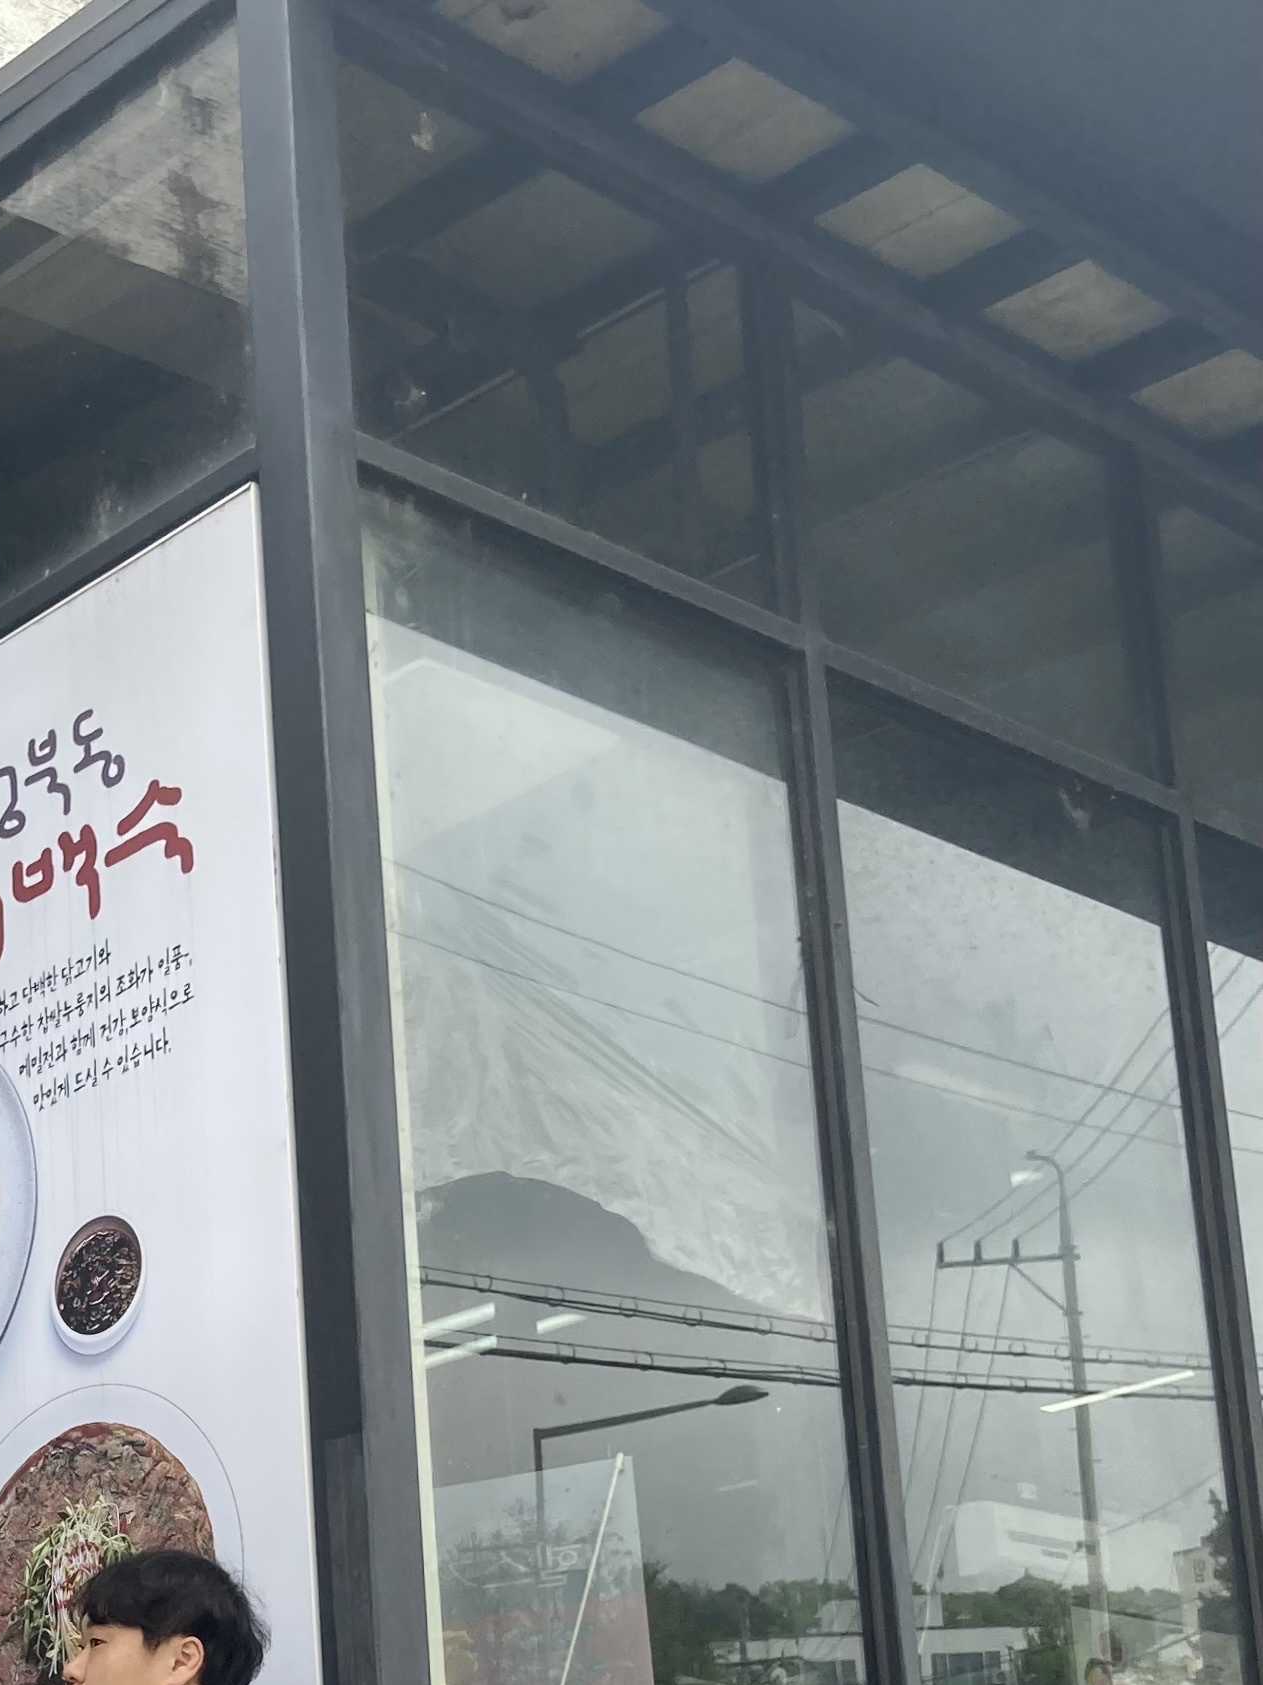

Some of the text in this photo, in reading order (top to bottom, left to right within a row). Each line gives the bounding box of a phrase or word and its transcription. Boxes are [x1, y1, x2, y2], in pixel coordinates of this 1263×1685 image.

[23, 965, 58, 1004] 담백한
[62, 938, 111, 985] 닭고기와
[38, 976, 111, 1034] 찹쌀누룽지의
[116, 956, 153, 997] 조화가
[19, 1036, 67, 1078] 메밀전과
[70, 1022, 96, 1056] 함께
[33, 1072, 70, 1112] 맛있게
[74, 1059, 98, 1092] 드실
